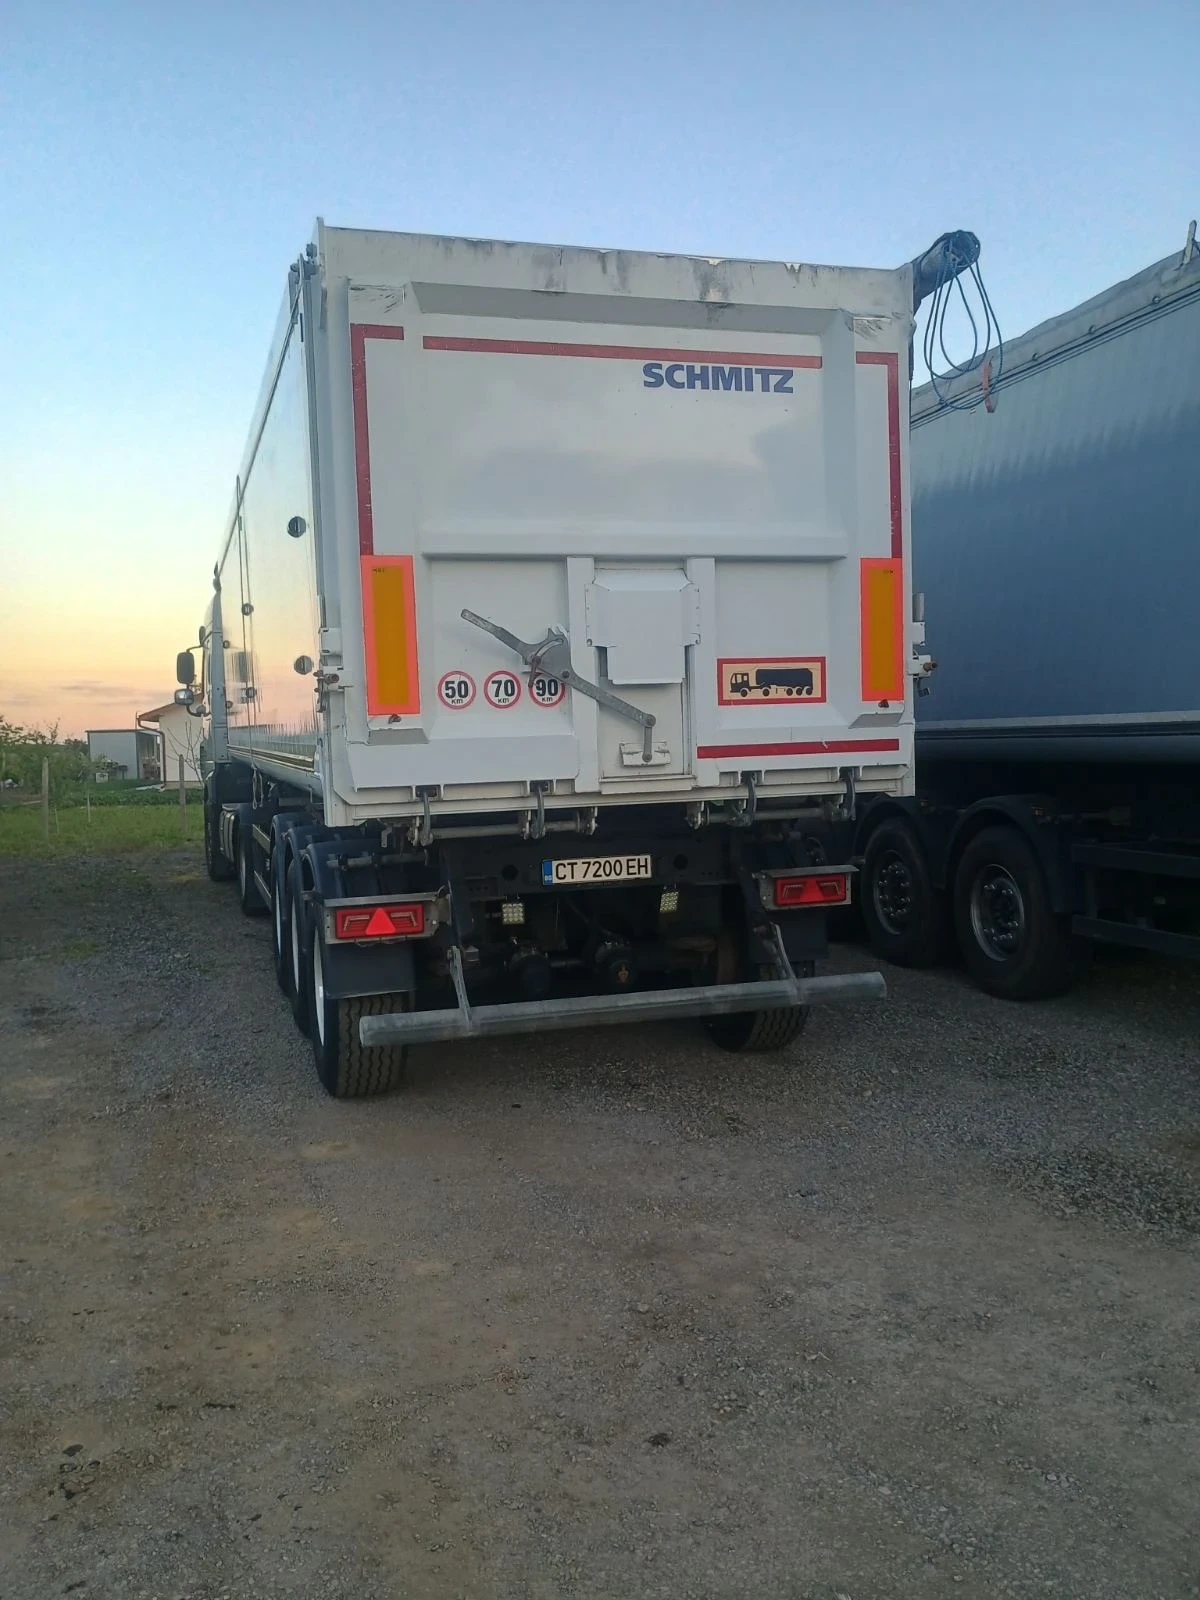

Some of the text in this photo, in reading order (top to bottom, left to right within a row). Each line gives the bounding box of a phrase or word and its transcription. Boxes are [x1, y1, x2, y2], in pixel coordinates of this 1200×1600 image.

[642, 363, 793, 393] SCHMITZ
[445, 681, 468, 698] 50
[491, 679, 515, 697] 70
[536, 679, 558, 697] 90
[555, 858, 648, 880] CT 7200 EH
